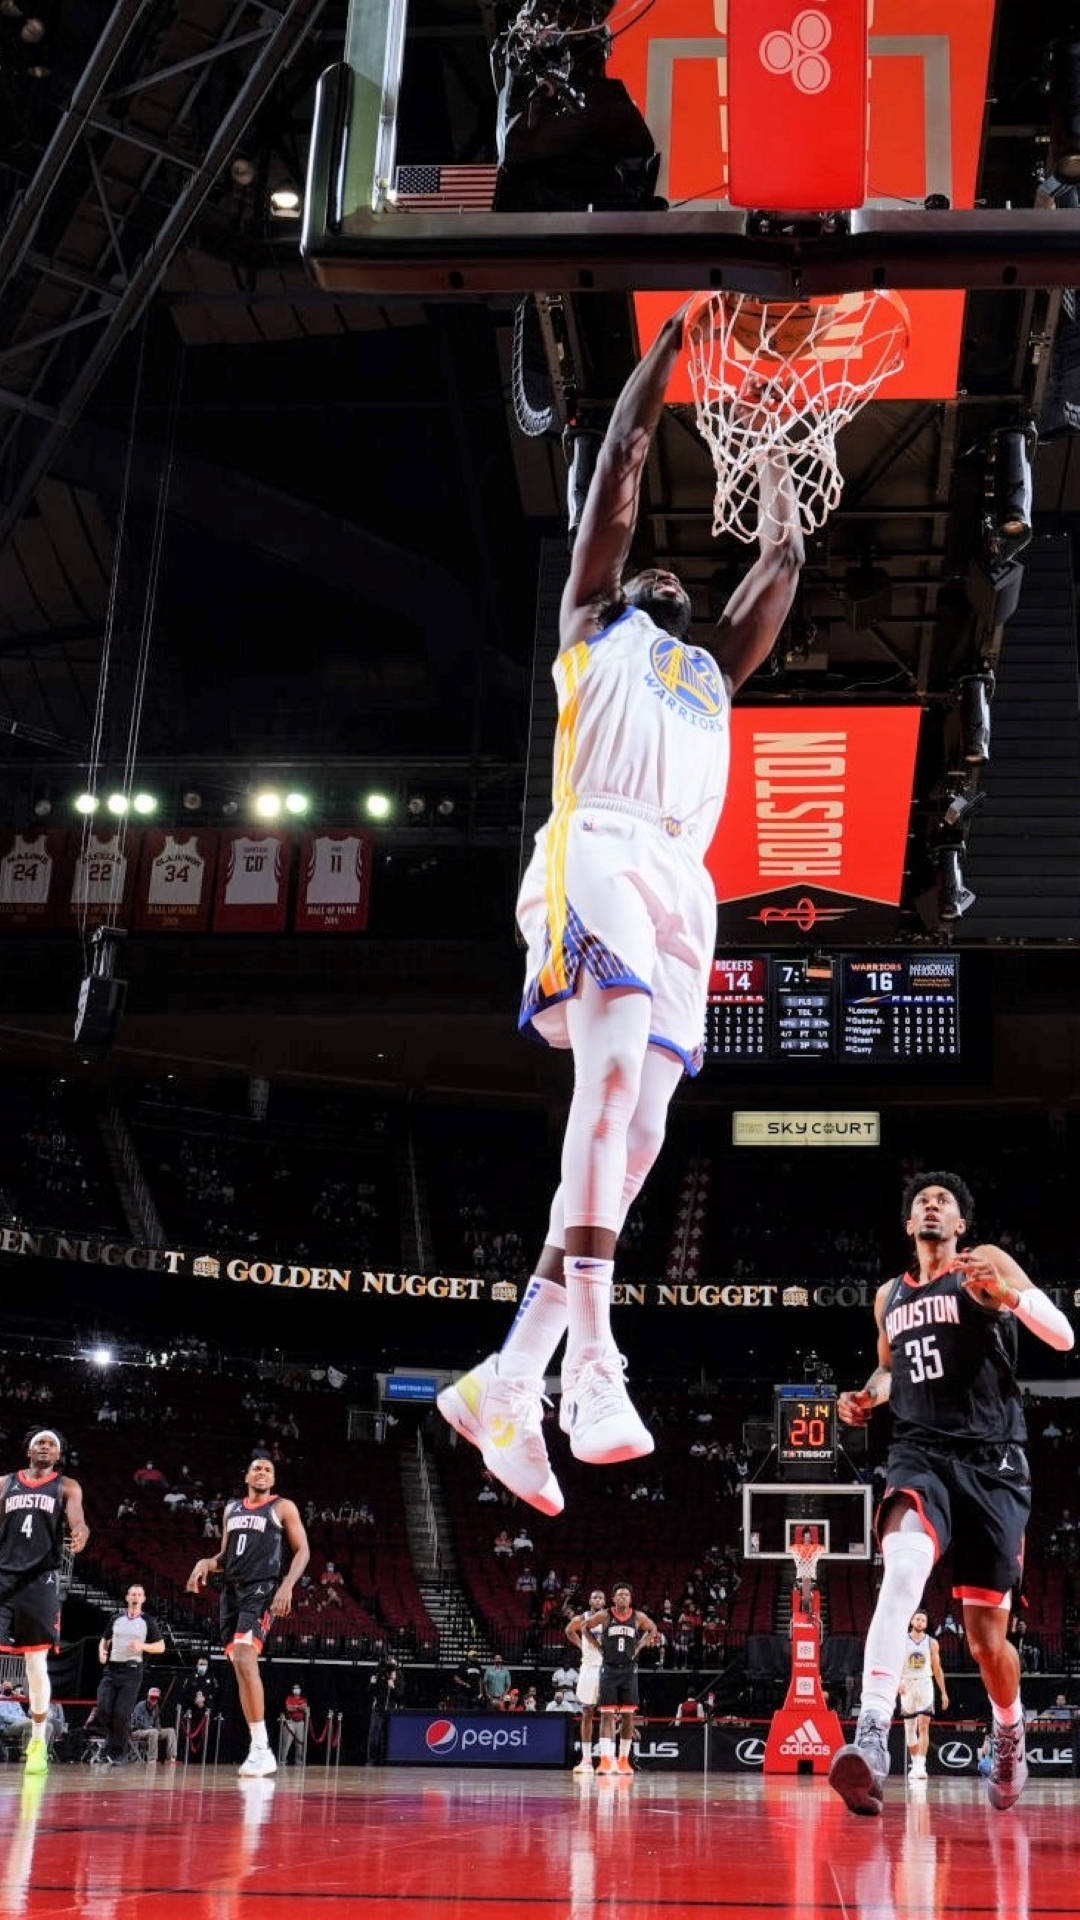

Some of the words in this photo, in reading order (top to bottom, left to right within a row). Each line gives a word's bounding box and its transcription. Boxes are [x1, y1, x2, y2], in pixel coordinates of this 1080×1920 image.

[644, 672, 723, 732] WARRIORS
[753, 732, 848, 876] HOUSTON
[14, 864, 38, 881] 24
[88, 864, 111, 881] 22
[164, 865, 190, 882] 34
[331, 855, 342, 873] 11
[851, 962, 902, 971] WARRIORS
[725, 972, 751, 990] 14
[867, 972, 892, 991] 16
[852, 1027, 881, 1035] Wiggins
[852, 1046, 872, 1054] Curry
[768, 1122, 806, 1134] SKY
[56, 1237, 184, 1274] NUGGET
[226, 1259, 351, 1292] GOLDEN
[362, 1271, 485, 1300] NUGGET
[657, 1284, 778, 1307] NUGGET
[885, 1295, 960, 1343] HOUSTON
[905, 1335, 944, 1384] 35
[798, 1404, 829, 1418] 7:14
[791, 1420, 825, 1445] 20
[5, 1494, 56, 1514] HOUSTON
[21, 1514, 33, 1538] 4
[226, 1515, 267, 1533] HOUSTON
[236, 1533, 247, 1556] 0
[462, 1725, 528, 1750] pepsi
[780, 1743, 831, 1755] adidas
